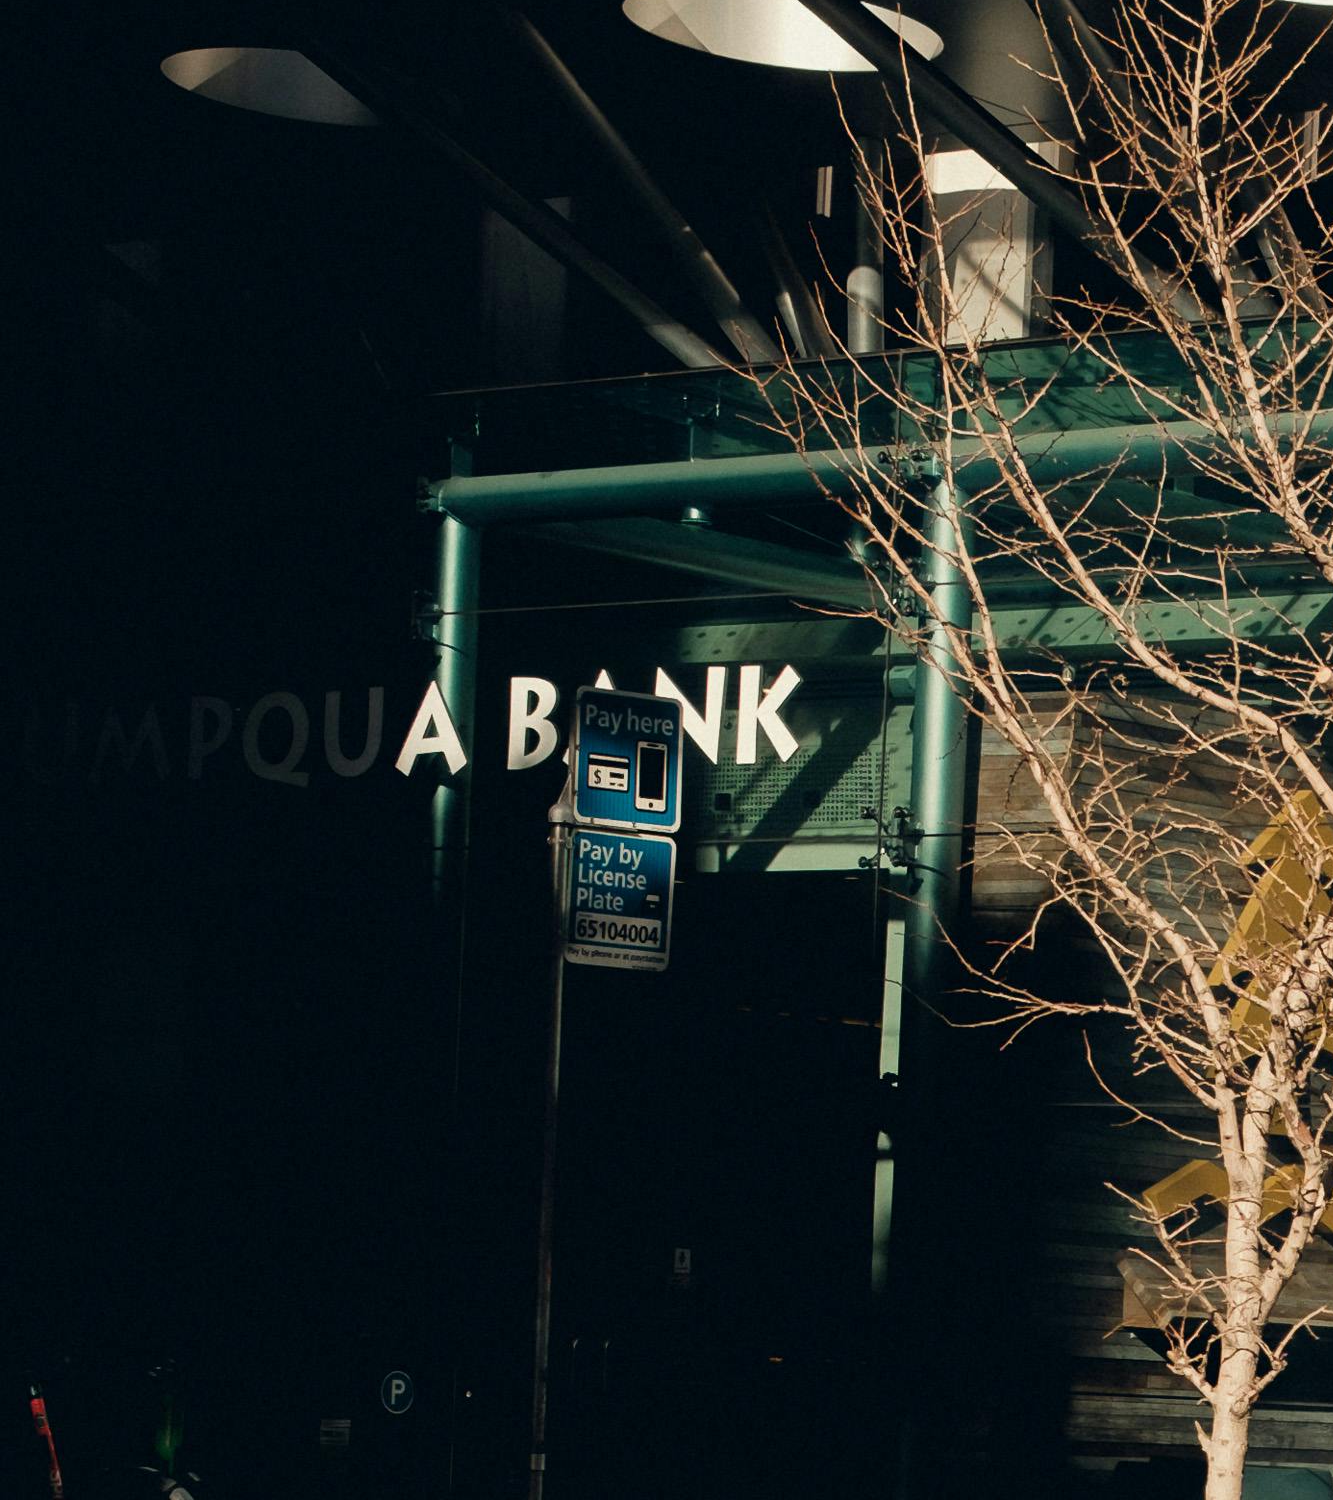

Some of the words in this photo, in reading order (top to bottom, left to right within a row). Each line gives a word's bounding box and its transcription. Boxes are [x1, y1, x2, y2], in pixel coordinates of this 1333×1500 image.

[507, 664, 802, 771] BNK
[585, 703, 622, 736] Pay
[627, 706, 674, 736] here
[579, 838, 614, 867] Pay
[618, 842, 643, 871] by
[578, 862, 647, 890] License
[576, 886, 624, 912] Plate
[577, 918, 659, 945] 65104004
[391, 1379, 406, 1405] P
